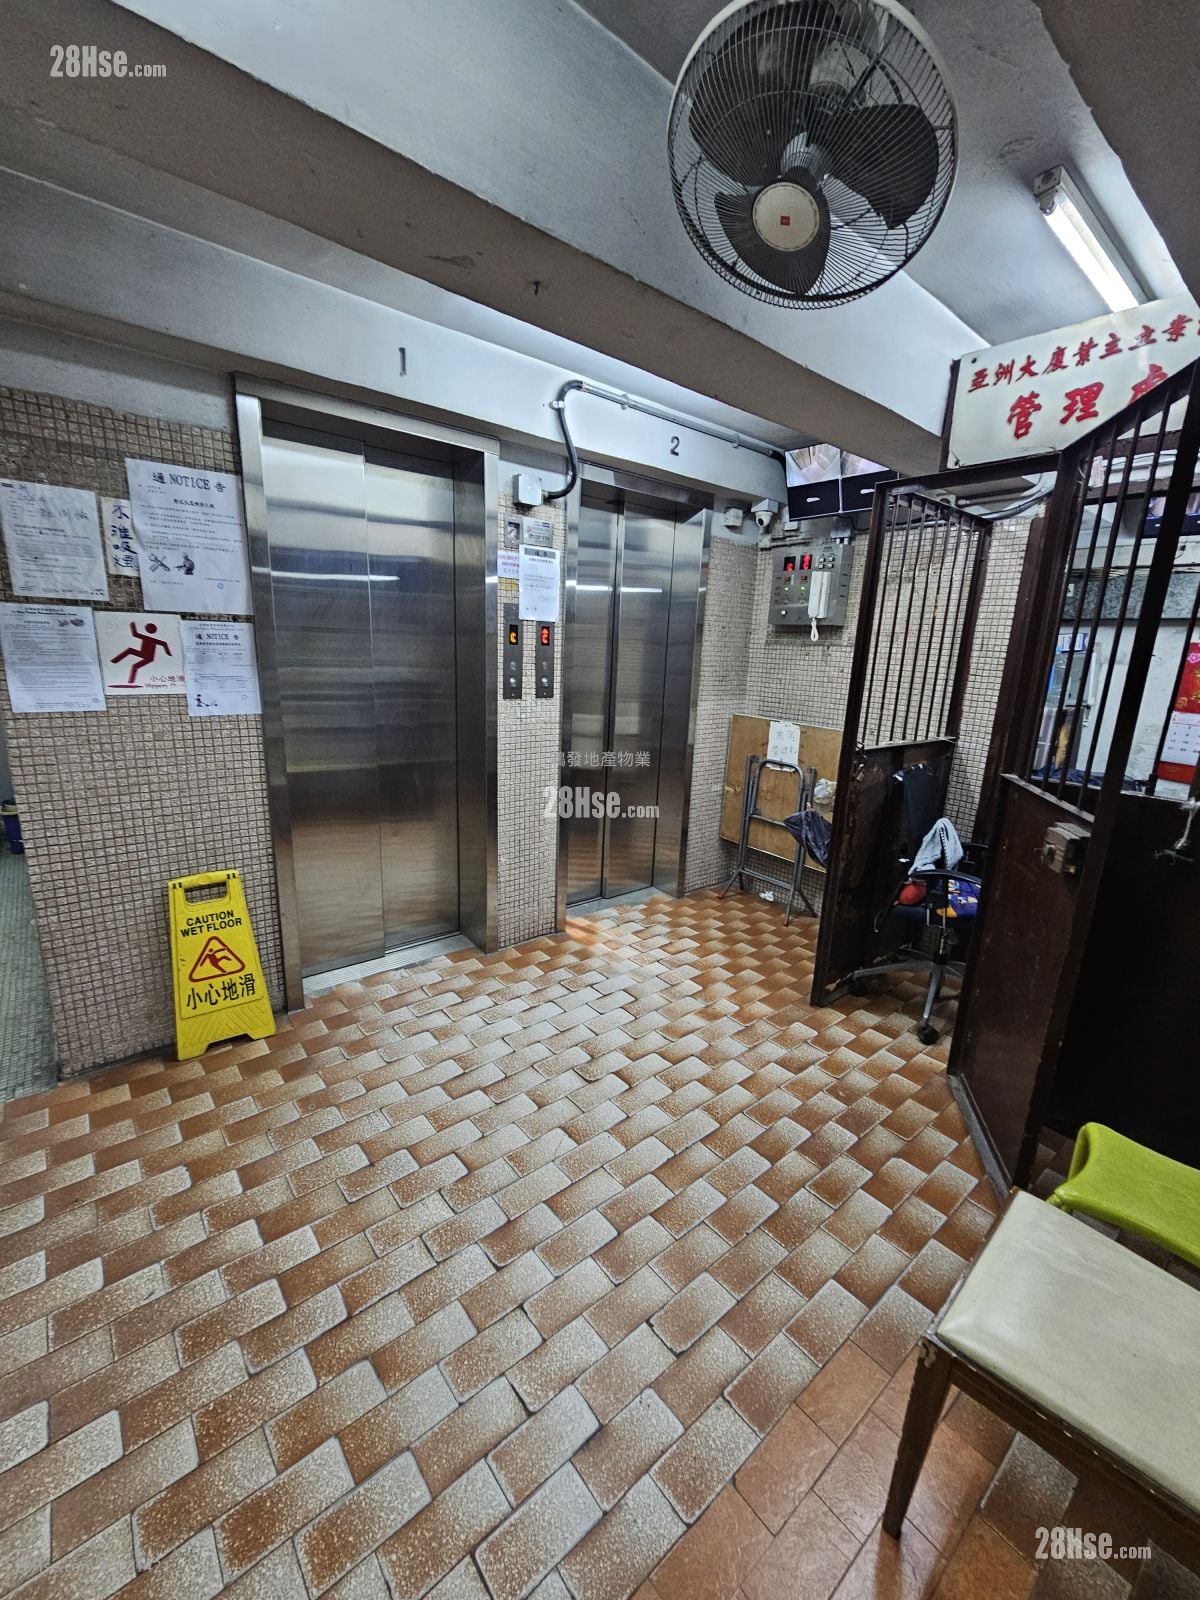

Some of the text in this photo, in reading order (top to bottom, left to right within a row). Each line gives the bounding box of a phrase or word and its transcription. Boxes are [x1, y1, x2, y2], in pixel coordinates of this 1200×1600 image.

[398, 347, 407, 377] 1
[669, 436, 680, 456] 2
[169, 473, 211, 490] NOTICE
[180, 917, 242, 938] WET FLOOR
[186, 910, 234, 927] CAUTION
[187, 973, 255, 1010] 小心地滑
